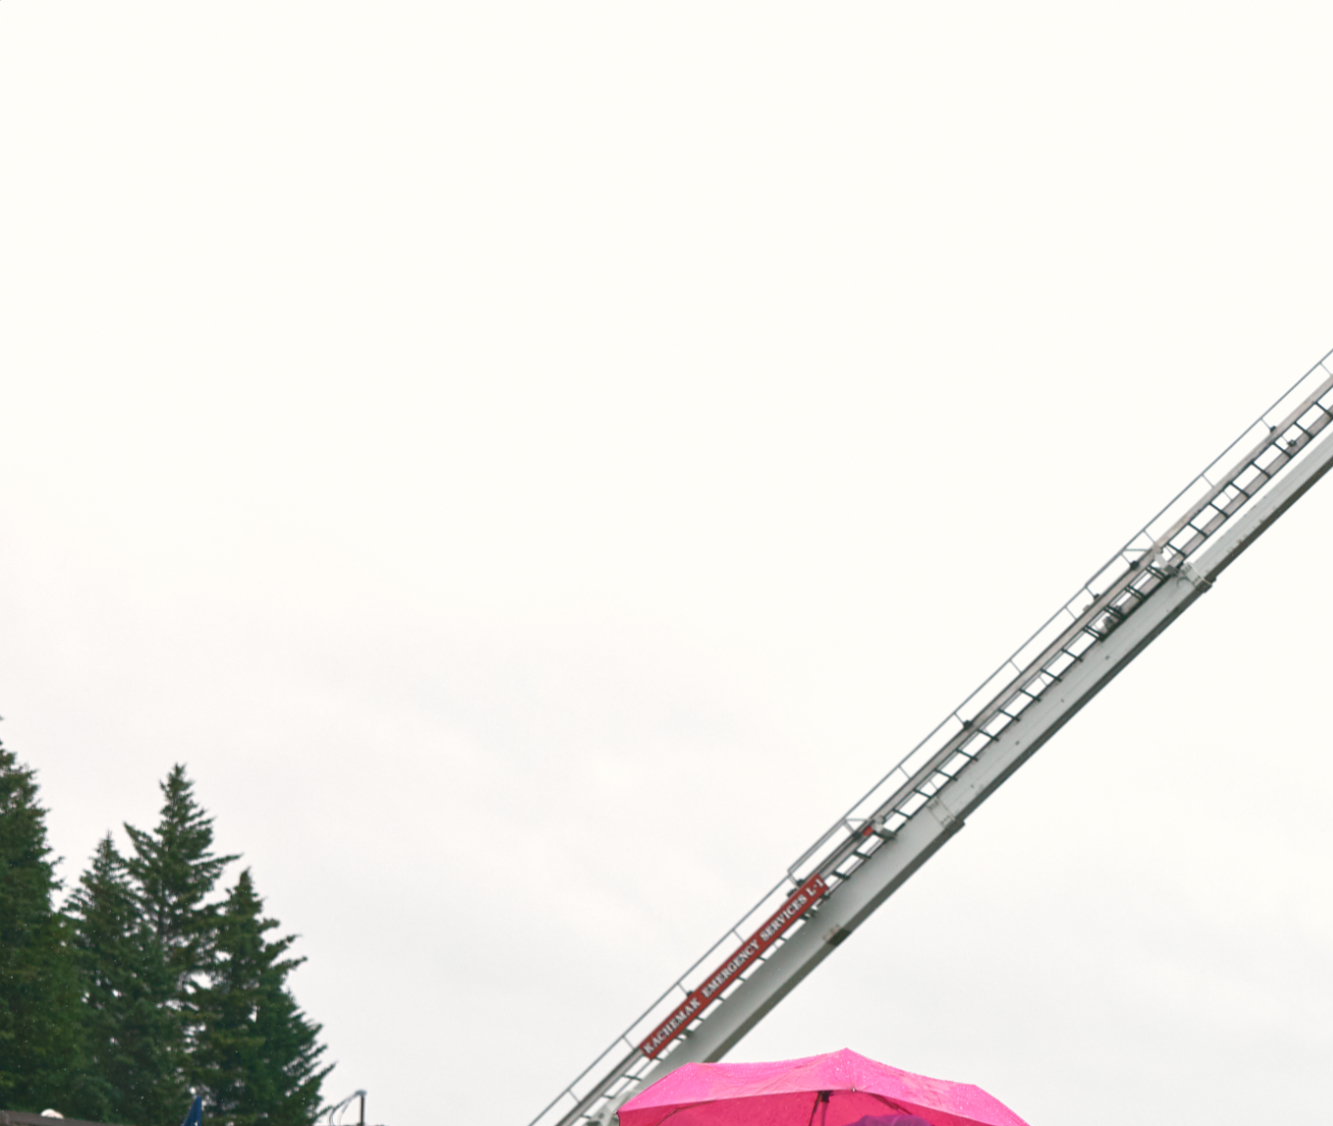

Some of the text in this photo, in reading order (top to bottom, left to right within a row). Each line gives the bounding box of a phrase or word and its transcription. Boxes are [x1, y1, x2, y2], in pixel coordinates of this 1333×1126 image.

[643, 998, 701, 1054] KACHEMAK
[701, 941, 760, 998] EMERGENCY
[759, 896, 808, 942] SERVICES
